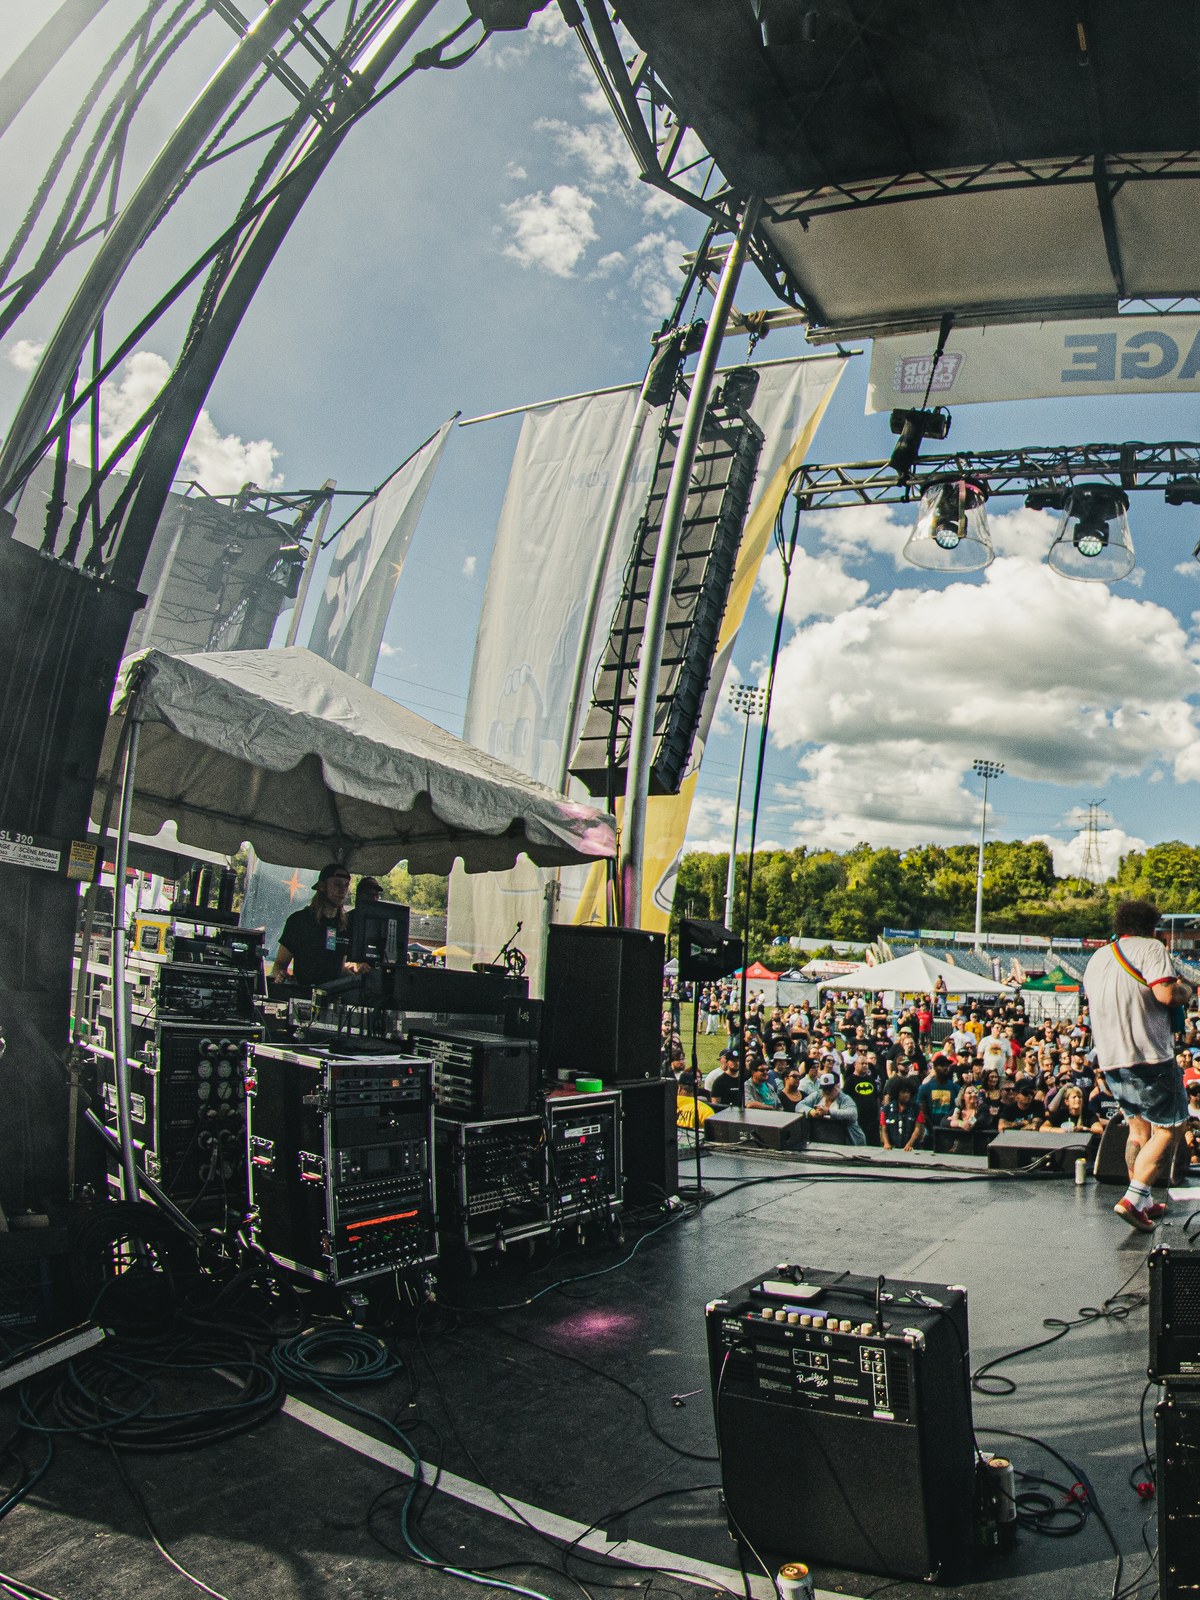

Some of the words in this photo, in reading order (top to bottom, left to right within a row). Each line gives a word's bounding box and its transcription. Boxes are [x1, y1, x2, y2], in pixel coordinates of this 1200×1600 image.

[0, 830, 11, 841] SL
[15, 833, 34, 845] 320
[38, 850, 59, 859] MOBILE
